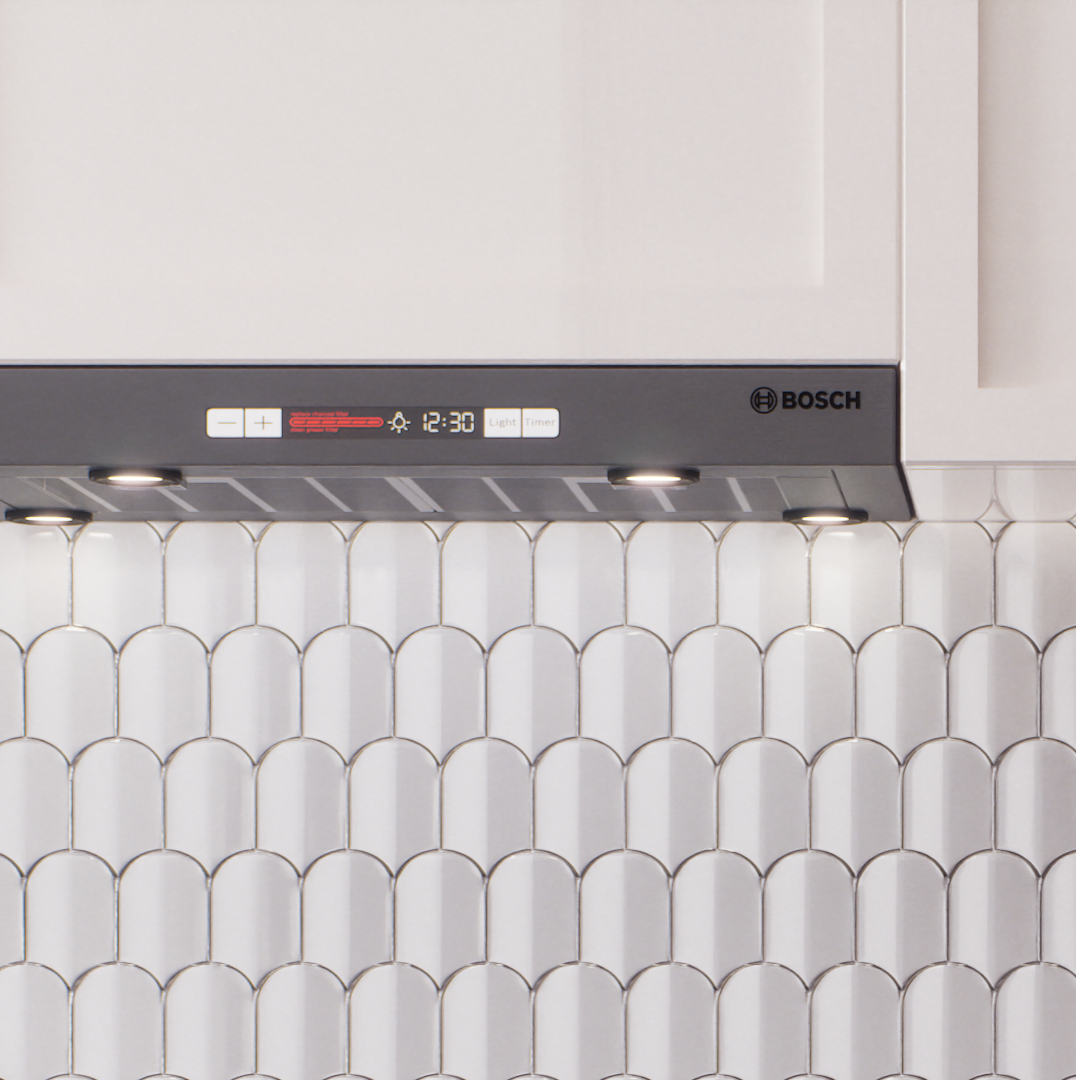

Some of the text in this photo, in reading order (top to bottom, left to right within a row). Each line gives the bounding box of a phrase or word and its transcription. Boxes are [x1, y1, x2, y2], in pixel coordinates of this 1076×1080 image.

[782, 391, 861, 410] BOSCH
[423, 412, 475, 433] 12:30
[489, 418, 517, 429] Light
[524, 418, 556, 427] Timer
